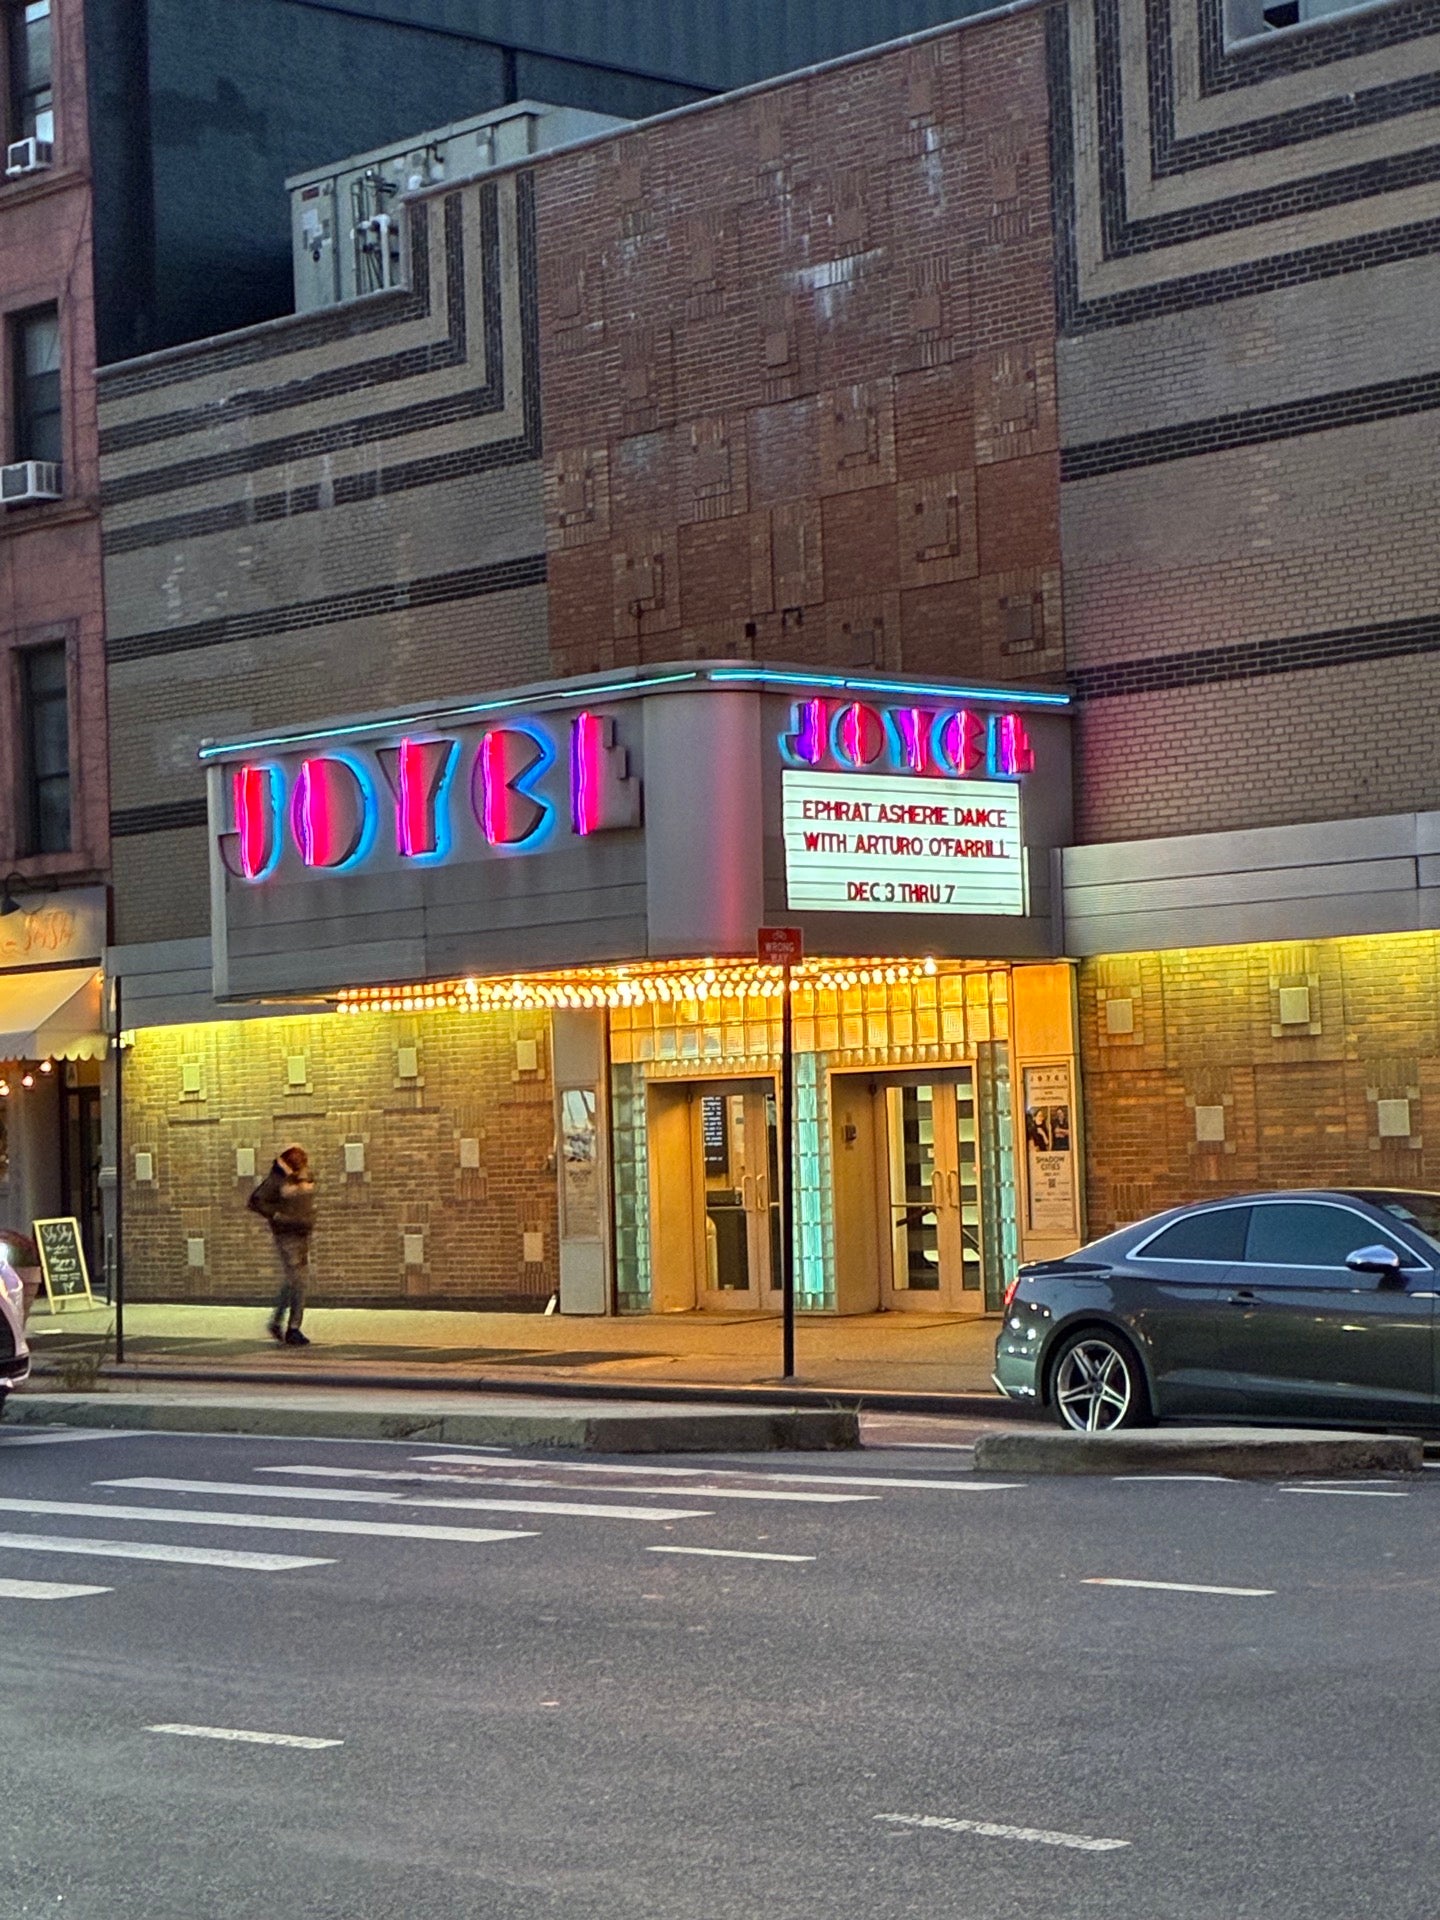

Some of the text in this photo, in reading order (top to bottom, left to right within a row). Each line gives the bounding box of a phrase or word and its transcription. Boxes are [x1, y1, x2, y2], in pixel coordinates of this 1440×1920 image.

[778, 697, 1035, 776] JOYCE
[217, 710, 645, 881] JOYCE
[802, 800, 1008, 828] EPHRAT ASHERIE DANCE
[802, 832, 1010, 858] WITH ARTURO O'FARRILL
[846, 881, 956, 904] DEC 3 THRU 7
[765, 942, 795, 953] WRONG
